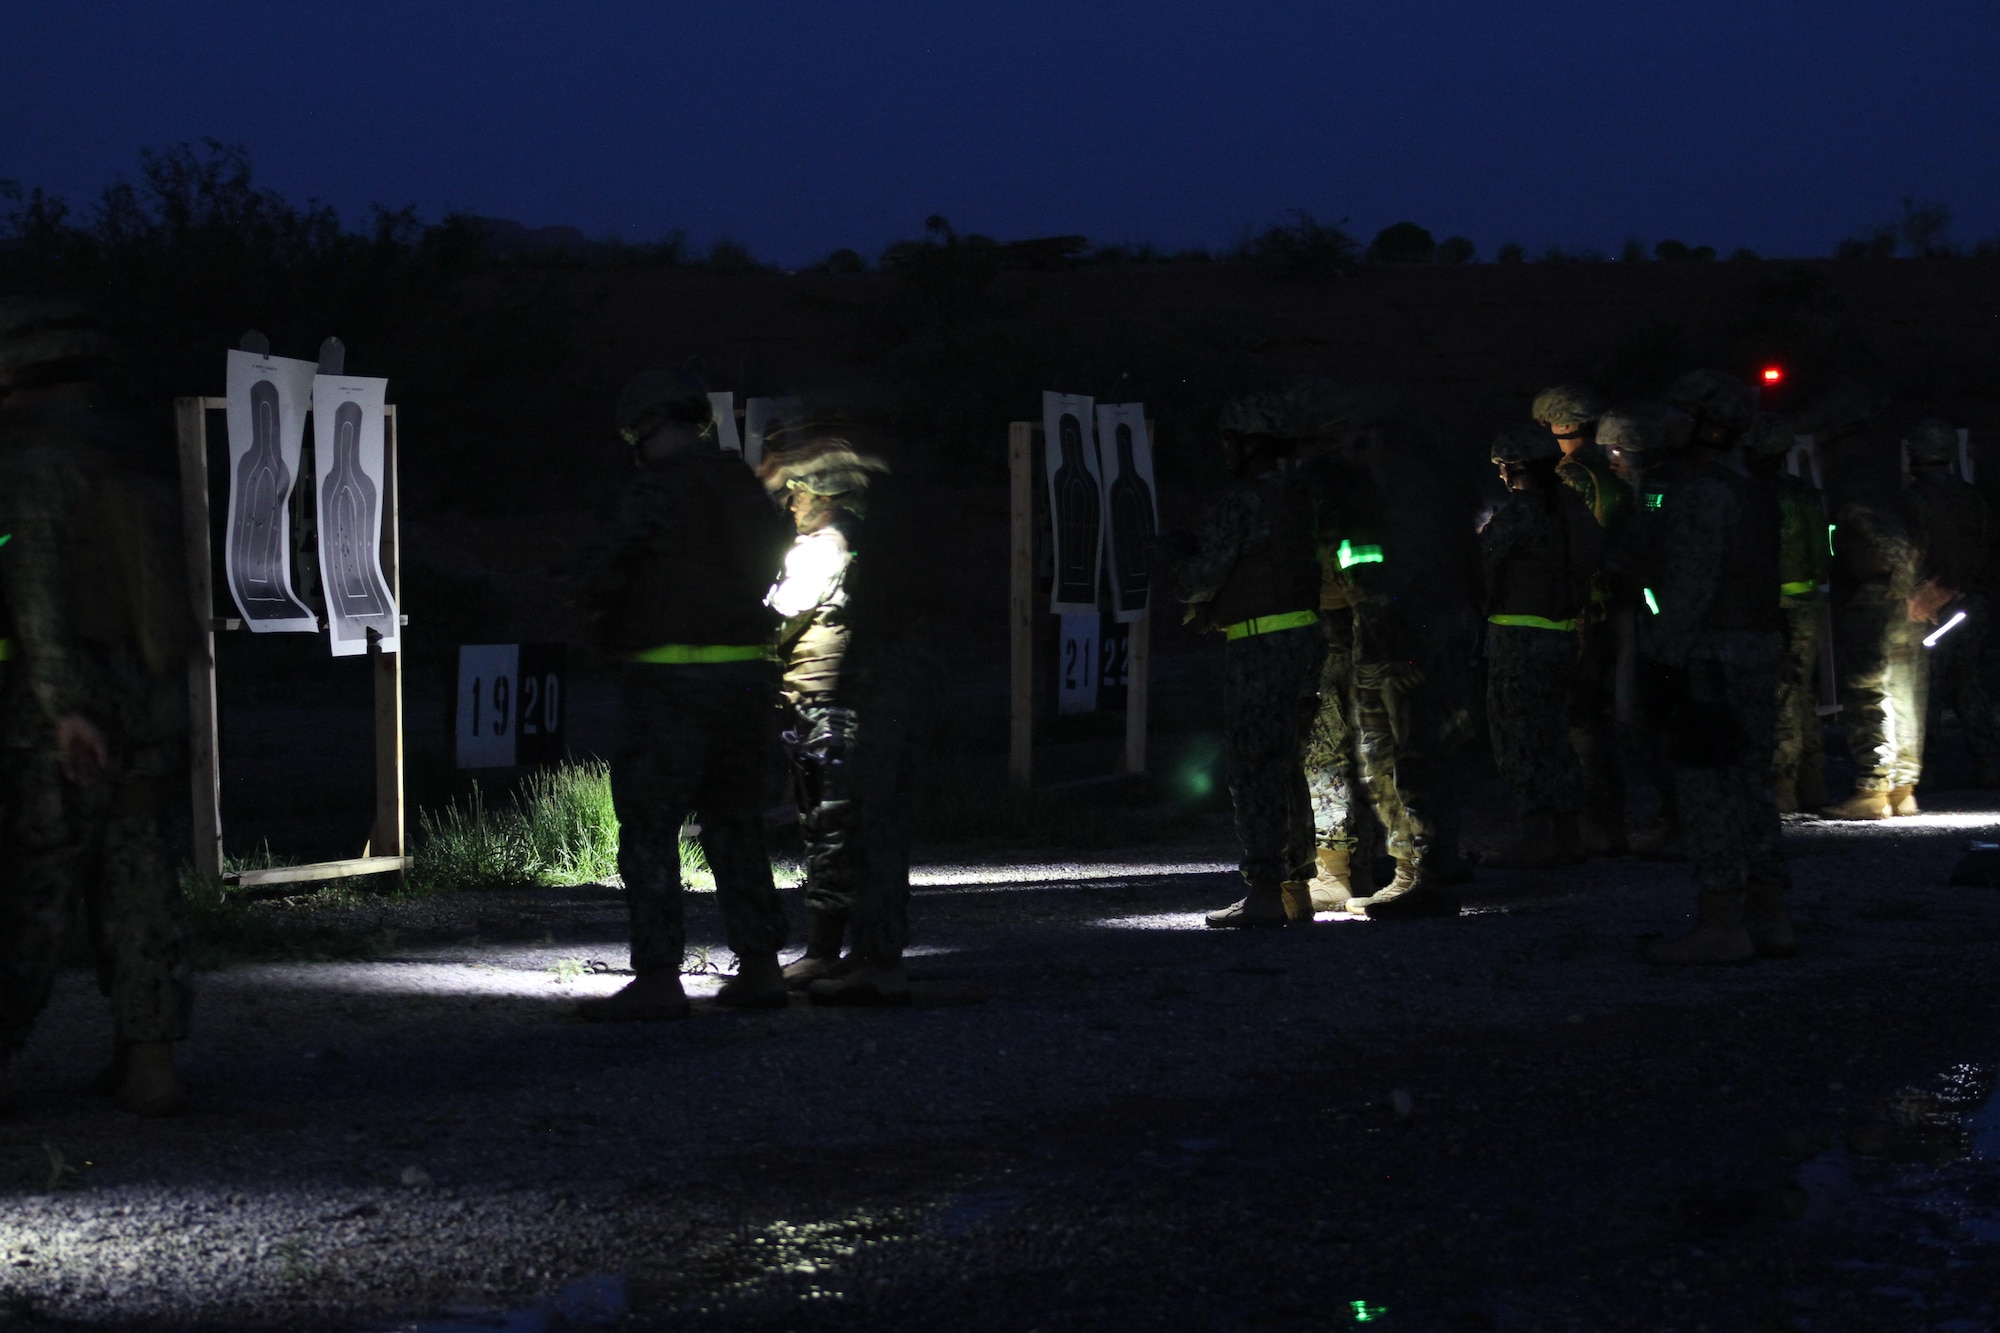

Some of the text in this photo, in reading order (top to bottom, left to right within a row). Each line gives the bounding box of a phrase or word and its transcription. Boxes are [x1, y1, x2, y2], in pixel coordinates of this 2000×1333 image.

[1066, 638, 1090, 690] 21
[473, 675, 509, 737] 19
[523, 672, 559, 735] 20
